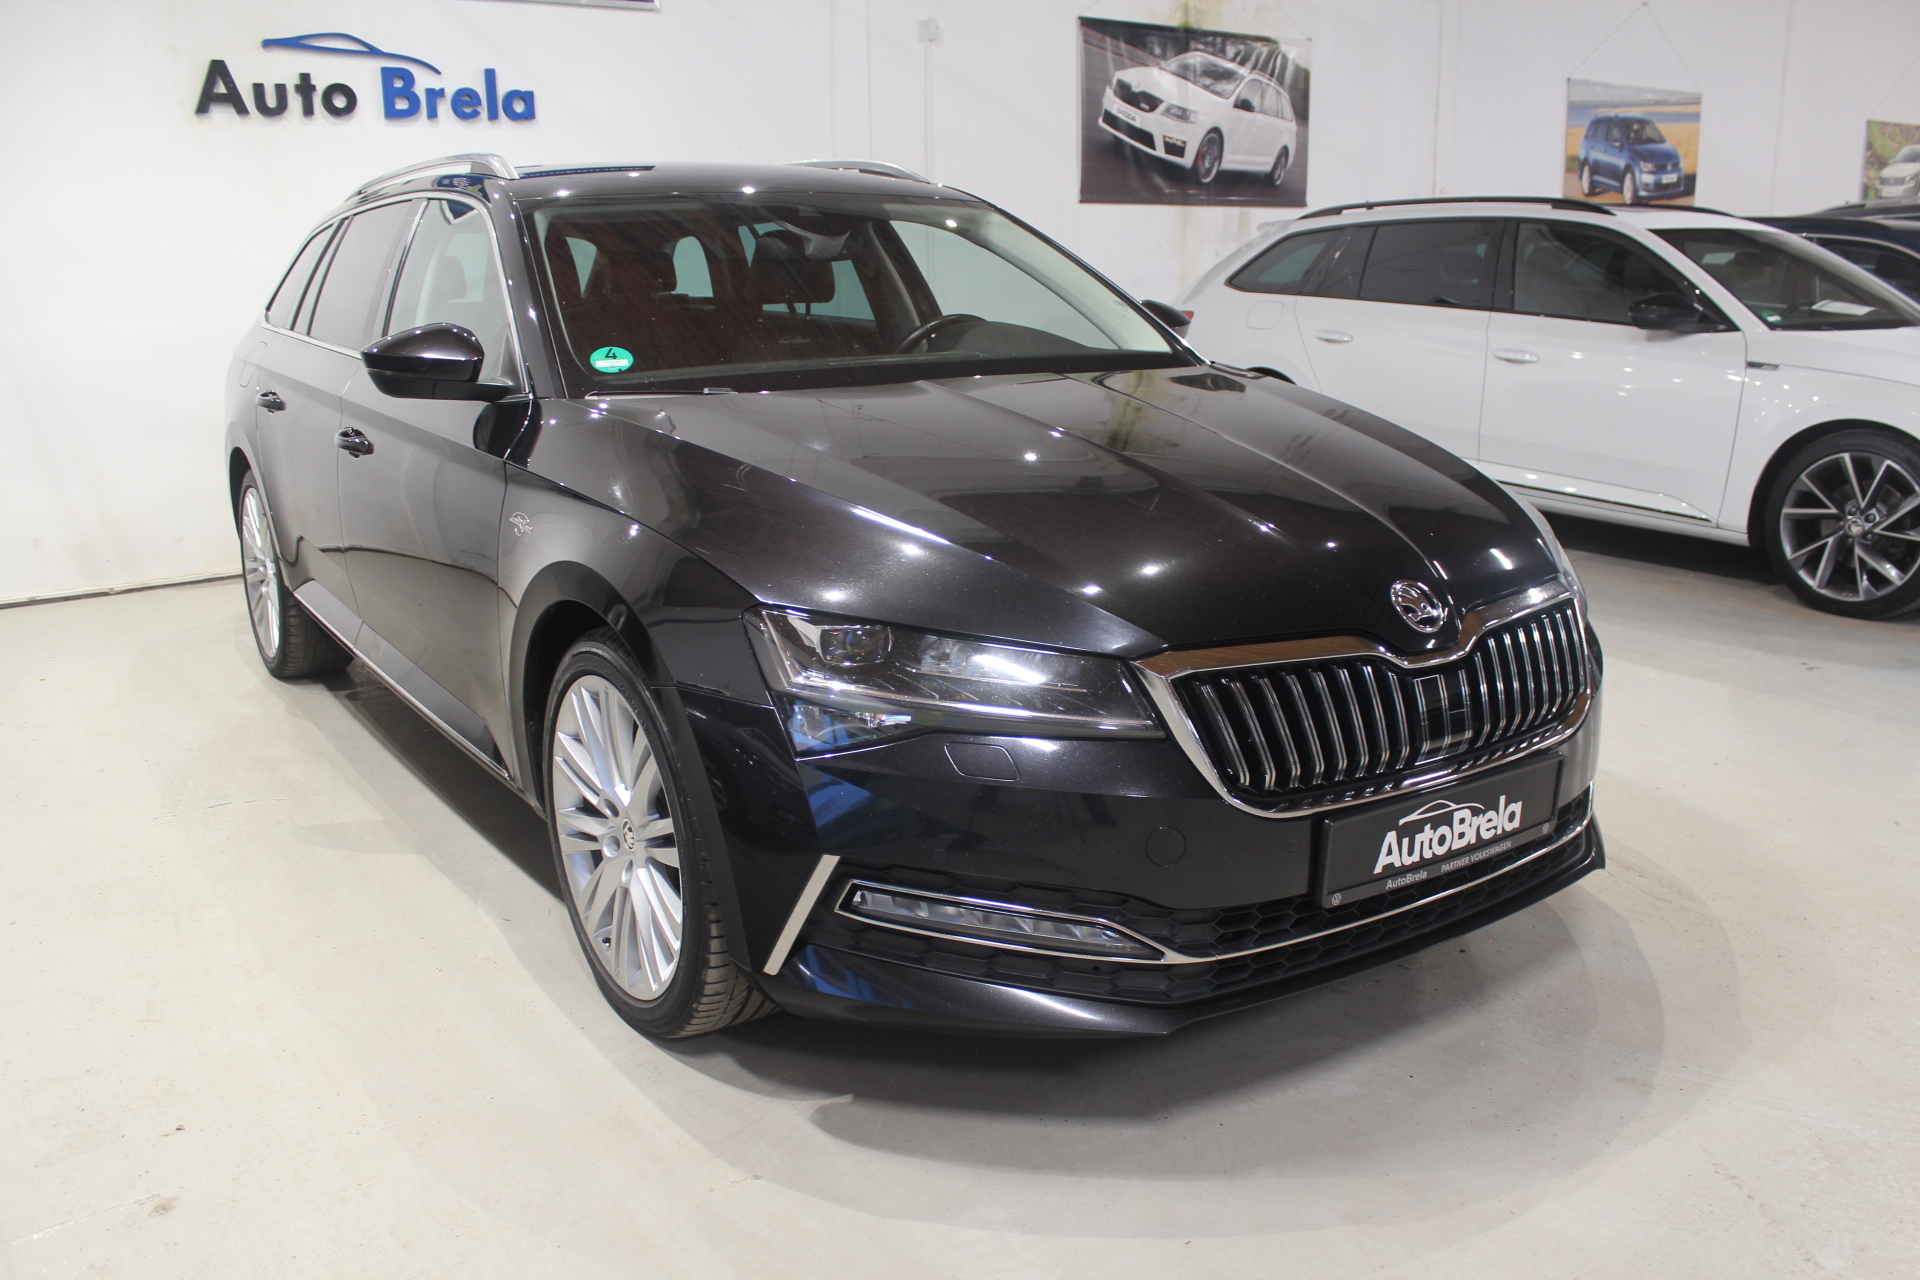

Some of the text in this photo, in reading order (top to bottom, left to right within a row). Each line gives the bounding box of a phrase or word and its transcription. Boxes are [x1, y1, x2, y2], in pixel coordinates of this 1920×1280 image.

[194, 59, 536, 121] Auto Brela
[605, 348, 617, 359] 4
[1373, 794, 1523, 874] AutoBrela
[1386, 841, 1511, 889] AutoBrela PARTNER VOLKSWAGEN
